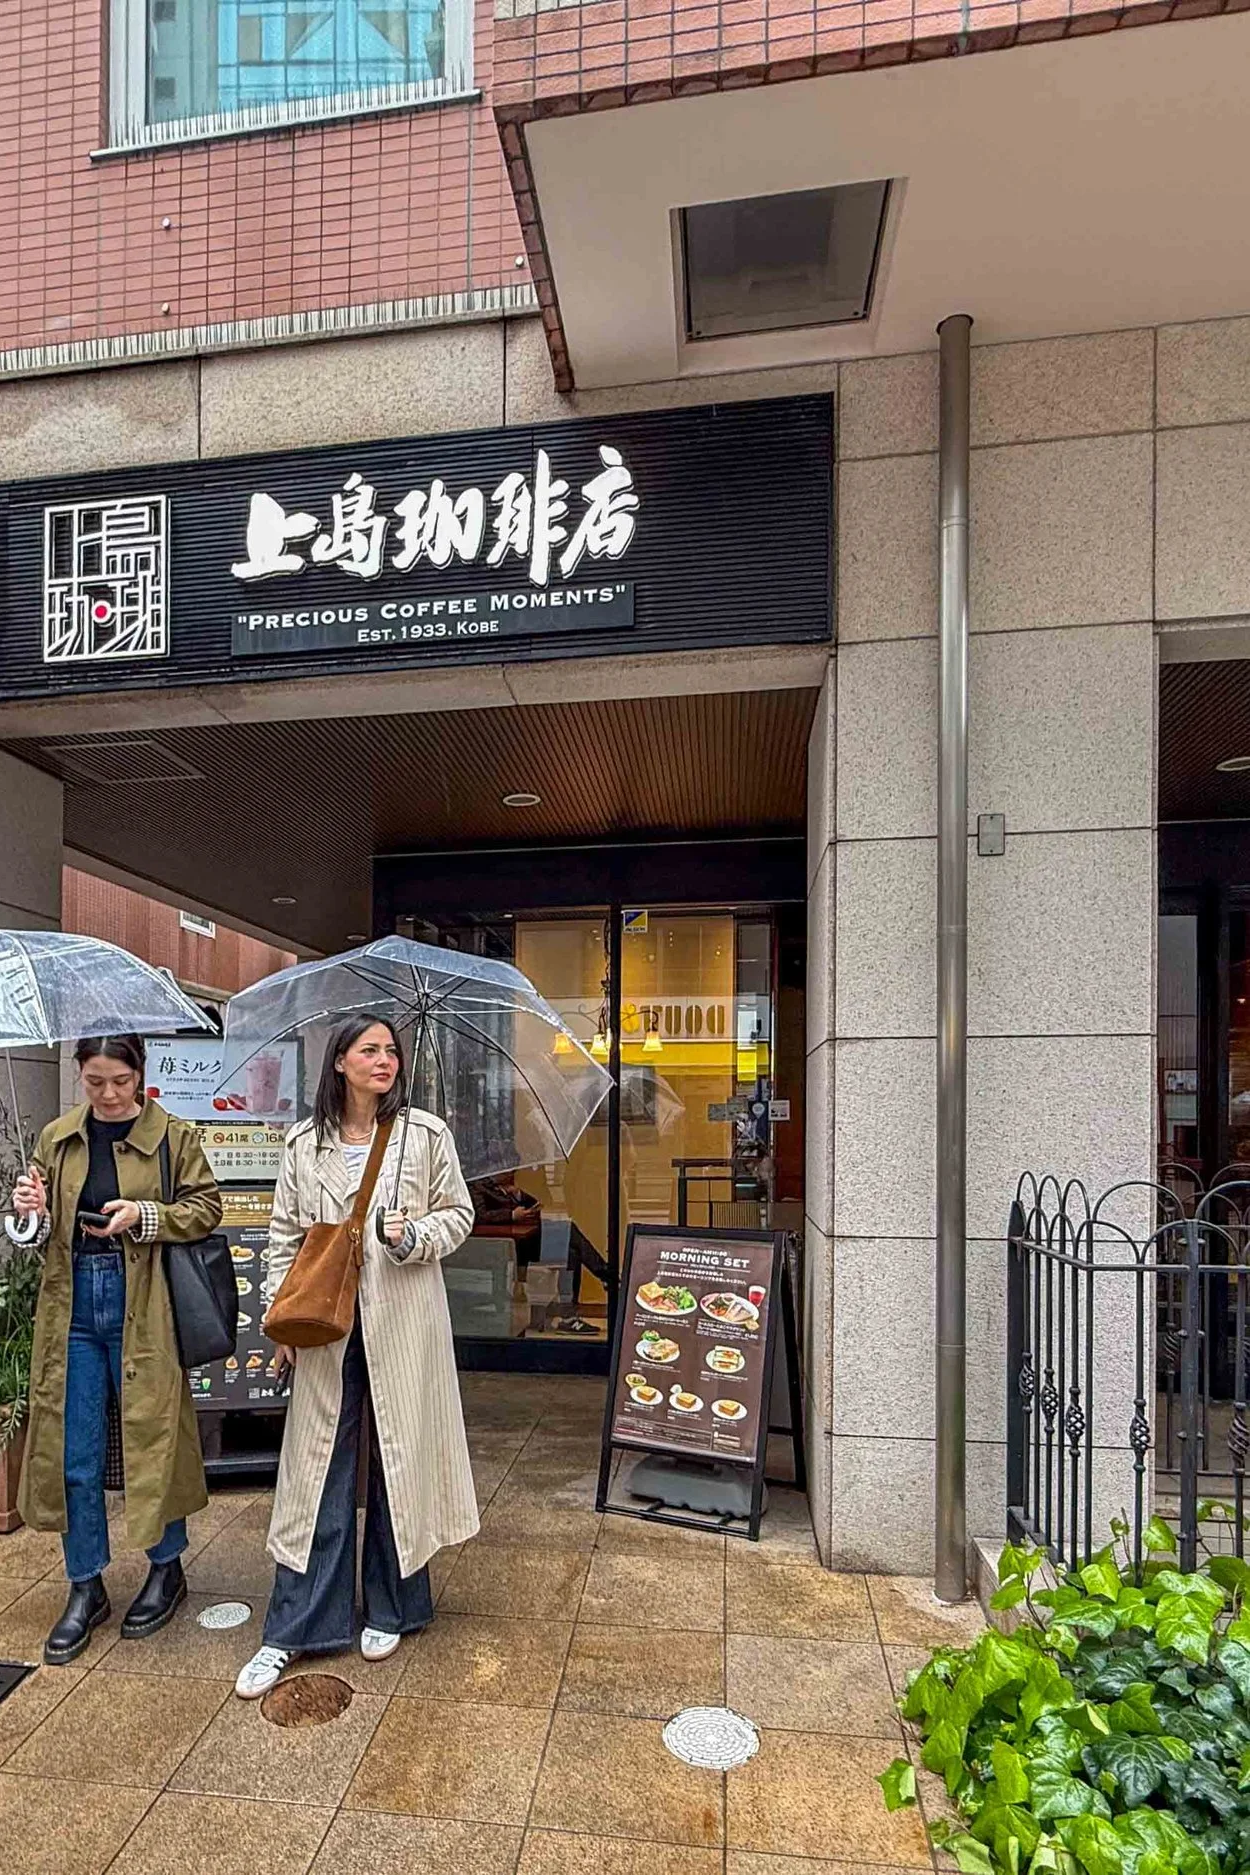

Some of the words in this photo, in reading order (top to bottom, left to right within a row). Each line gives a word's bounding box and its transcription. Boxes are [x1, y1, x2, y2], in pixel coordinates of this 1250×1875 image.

[230, 445, 640, 587] 上島珈琲店
[380, 599, 477, 620] COFFEE
[456, 620, 499, 635] KOBE
[660, 1251, 719, 1265] MORNING
[724, 1257, 750, 1268] SET
